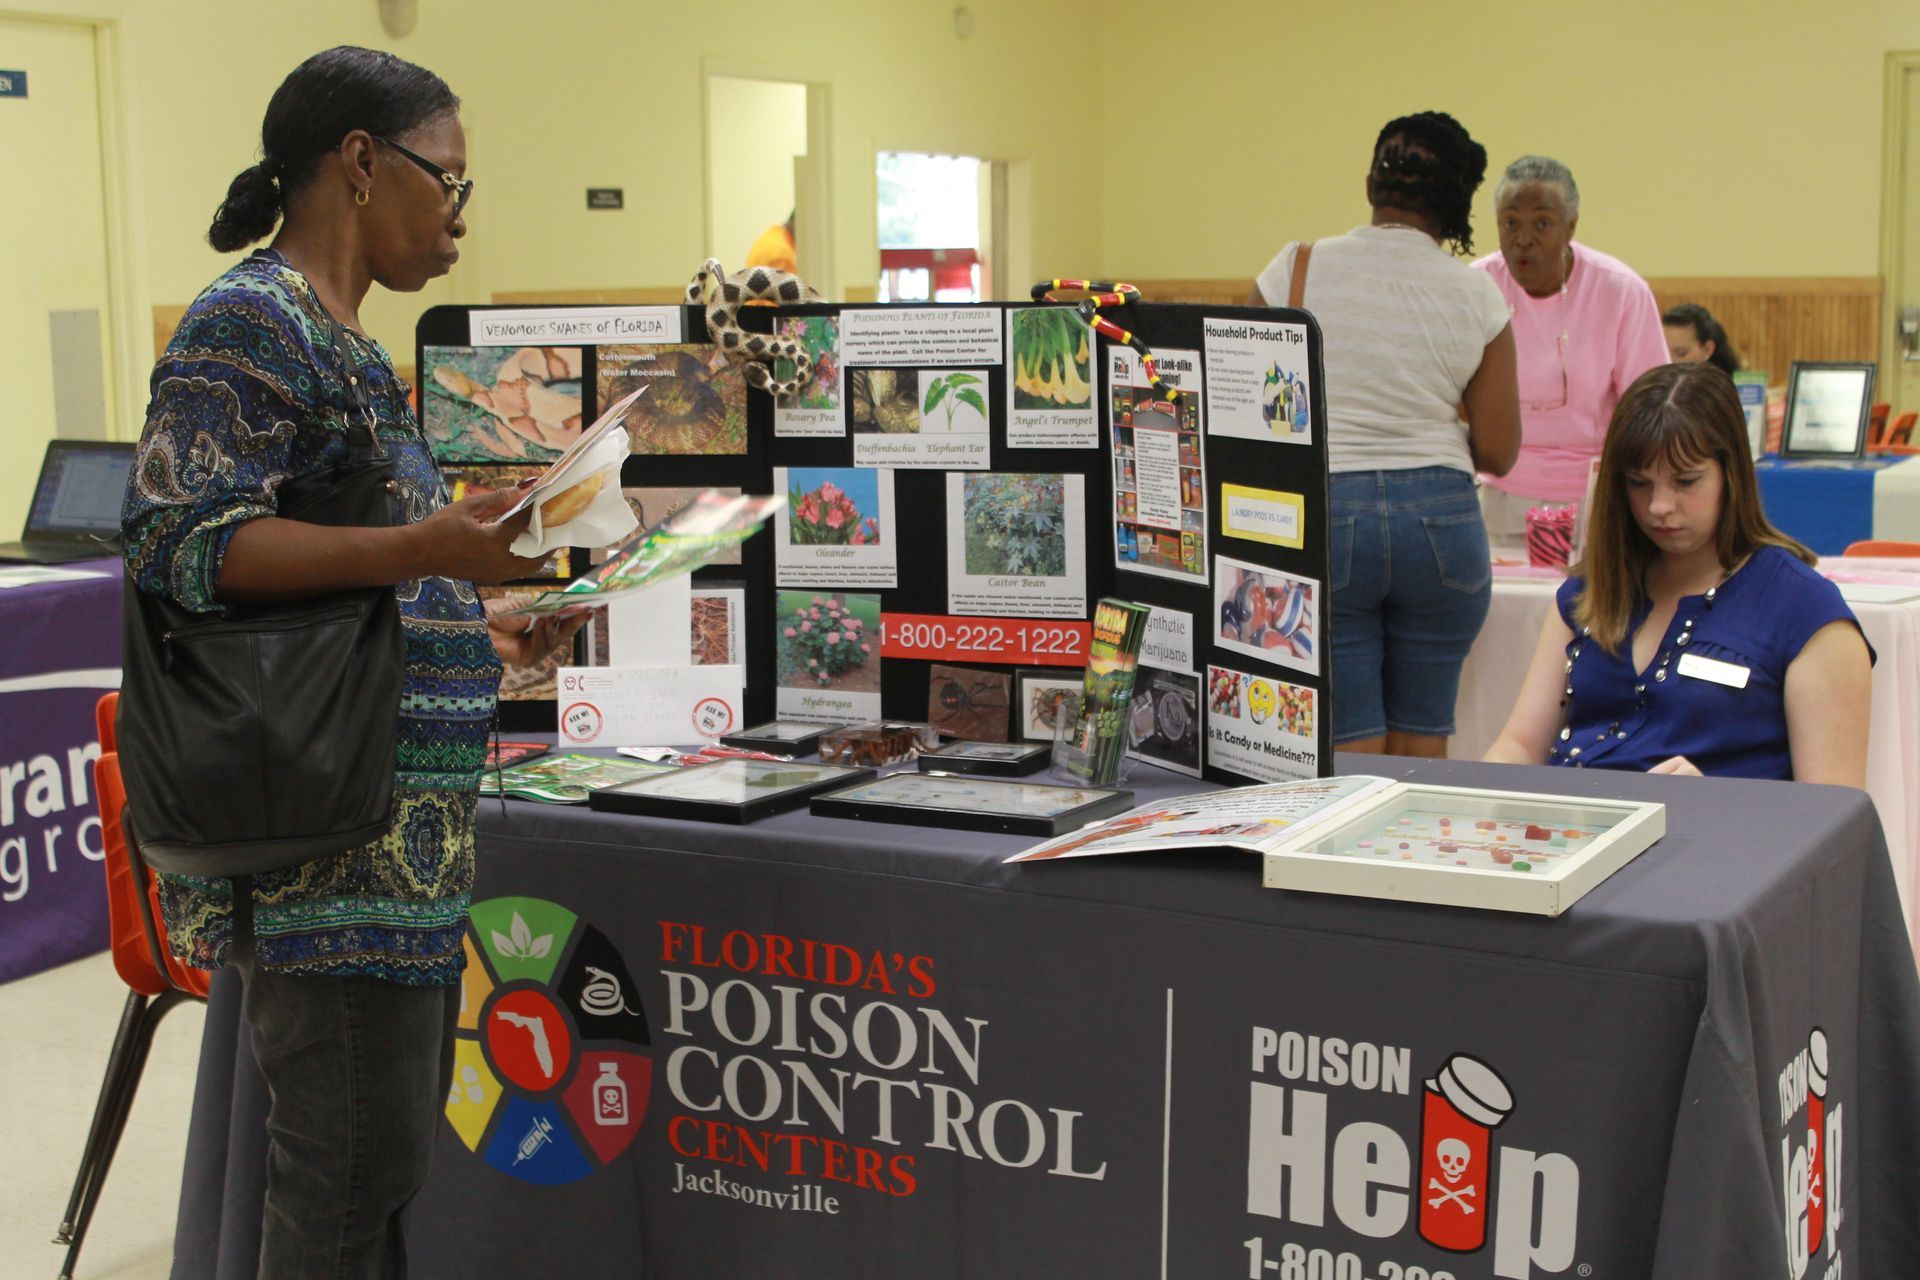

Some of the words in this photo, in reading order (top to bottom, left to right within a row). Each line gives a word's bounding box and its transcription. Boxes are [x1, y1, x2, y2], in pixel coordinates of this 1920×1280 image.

[951, 311, 991, 321] FLORIDA
[486, 324, 546, 336] VENOMOUS
[549, 322, 592, 335] SNAKES
[597, 321, 609, 334] OF
[615, 318, 663, 334] FLORIDA
[1205, 324, 1247, 339] Household
[1249, 327, 1283, 342] Product
[1285, 329, 1303, 345] Tips
[600, 353, 656, 361] Cottonmouth
[1161, 358, 1192, 372] Look-alike
[599, 369, 628, 377] (Water
[630, 369, 676, 377] Moccasin)
[785, 413, 816, 424] Rosary
[820, 413, 835, 422] Pea
[1014, 414, 1048, 428] Angel's
[1051, 415, 1093, 428] Trumpet
[927, 443, 966, 455] Elephant
[969, 444, 986, 453] Ear
[816, 548, 855, 558] Oleander
[988, 578, 1018, 587] Castor
[1021, 578, 1046, 588] Bean
[1147, 616, 1185, 634] ynthetic
[880, 622, 1081, 654] 1-800-222-1222
[801, 696, 852, 709] Hydrangea
[1208, 726, 1214, 739] Is
[1216, 729, 1222, 741] it
[1224, 730, 1251, 750] Candy
[1253, 741, 1261, 751] or
[1264, 741, 1316, 766] Medicine???
[659, 920, 936, 999] FLORIDA'S
[660, 969, 989, 1085] POISON
[1251, 1025, 1411, 1095] POISON
[666, 1045, 1107, 1181] CONTROL
[668, 1114, 917, 1197] CENTERS
[673, 1162, 840, 1215] Jacksonville
